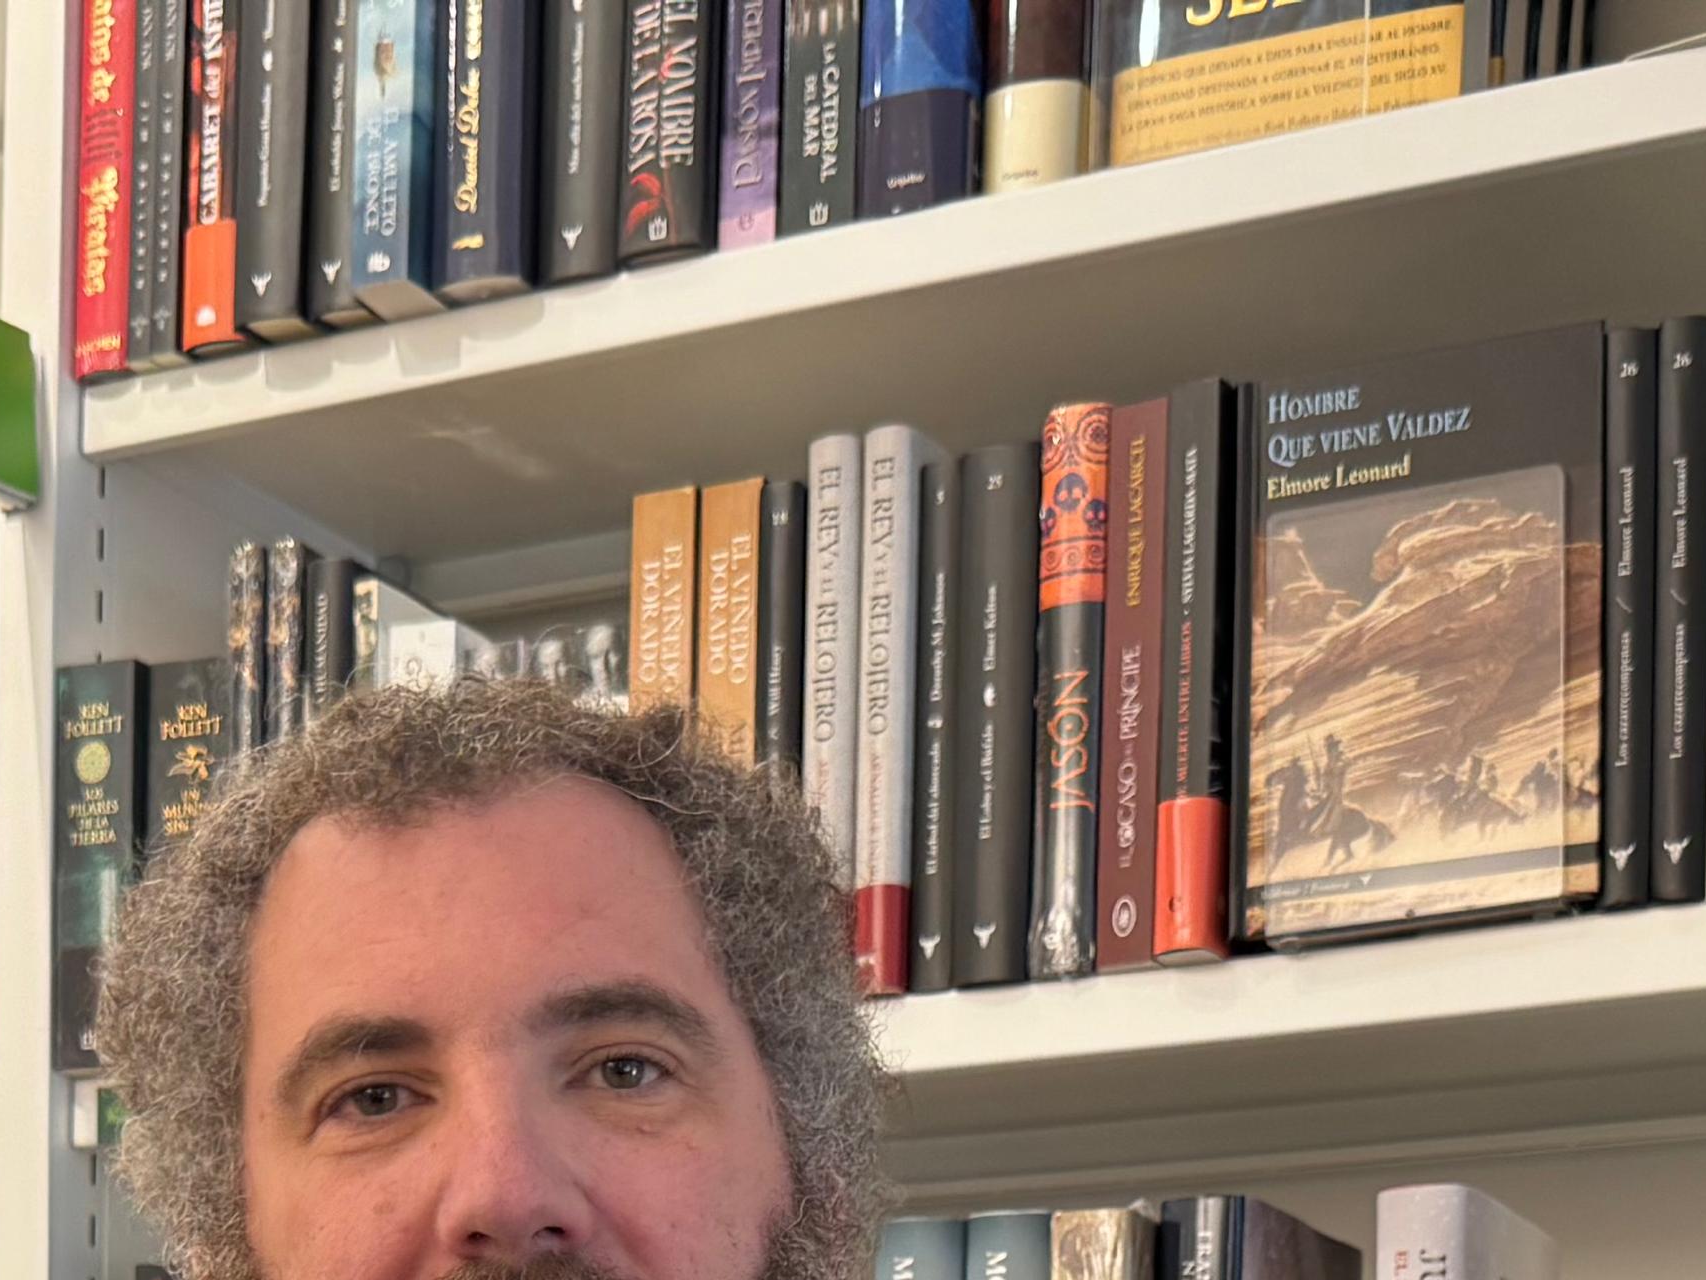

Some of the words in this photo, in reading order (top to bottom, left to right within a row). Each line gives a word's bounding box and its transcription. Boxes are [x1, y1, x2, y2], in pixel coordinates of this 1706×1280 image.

[803, 104, 820, 157] MAR
[820, 64, 840, 183] CATEDRAL
[1268, 387, 1361, 424] HOMBRE
[1268, 429, 1316, 468] QUE
[1320, 421, 1381, 454] VIENE
[1387, 407, 1471, 443] VALDEZ
[1266, 470, 1331, 501] Elmore
[1335, 454, 1412, 488] Leonard
